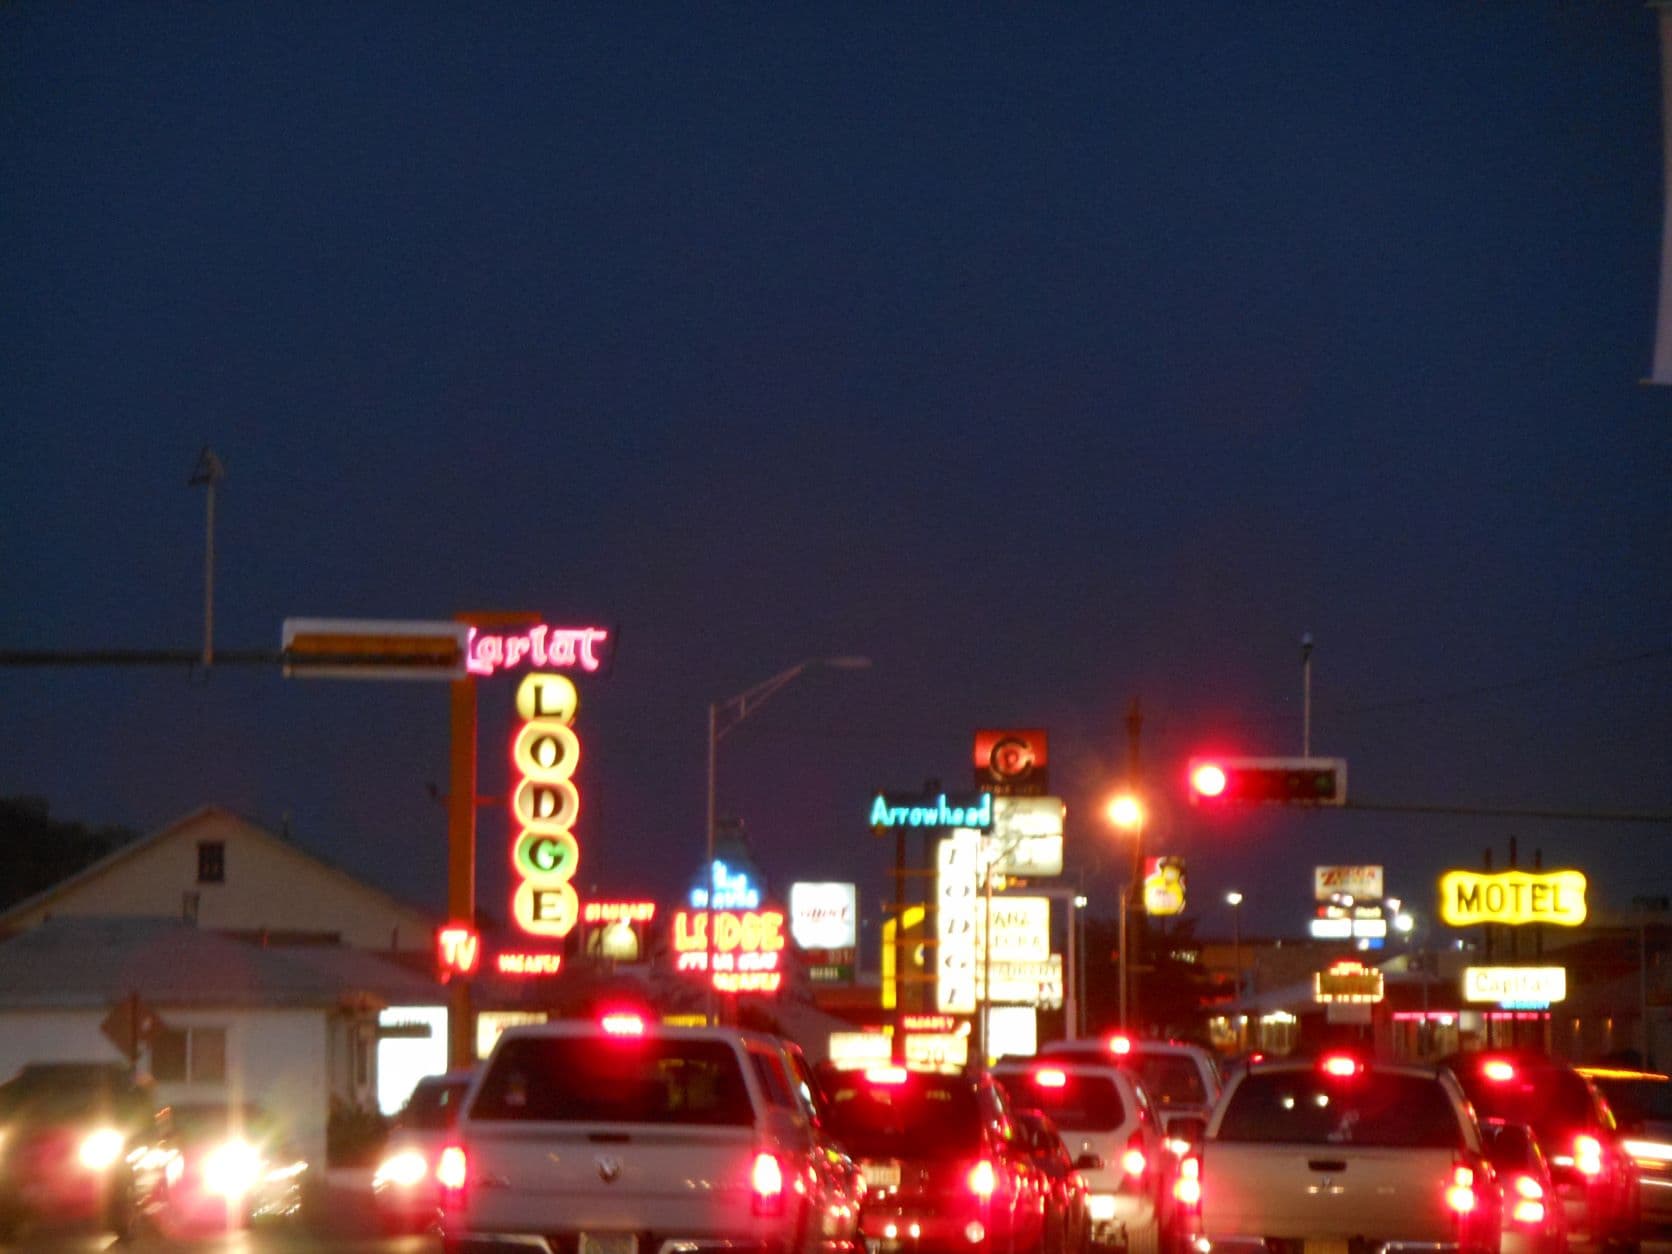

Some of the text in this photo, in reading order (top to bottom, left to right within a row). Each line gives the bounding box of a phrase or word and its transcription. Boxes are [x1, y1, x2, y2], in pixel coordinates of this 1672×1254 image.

[527, 683, 567, 923] LODGE
[871, 792, 991, 827] Arrowhead
[1457, 883, 1571, 913] MOTEL
[441, 930, 476, 971] TV
